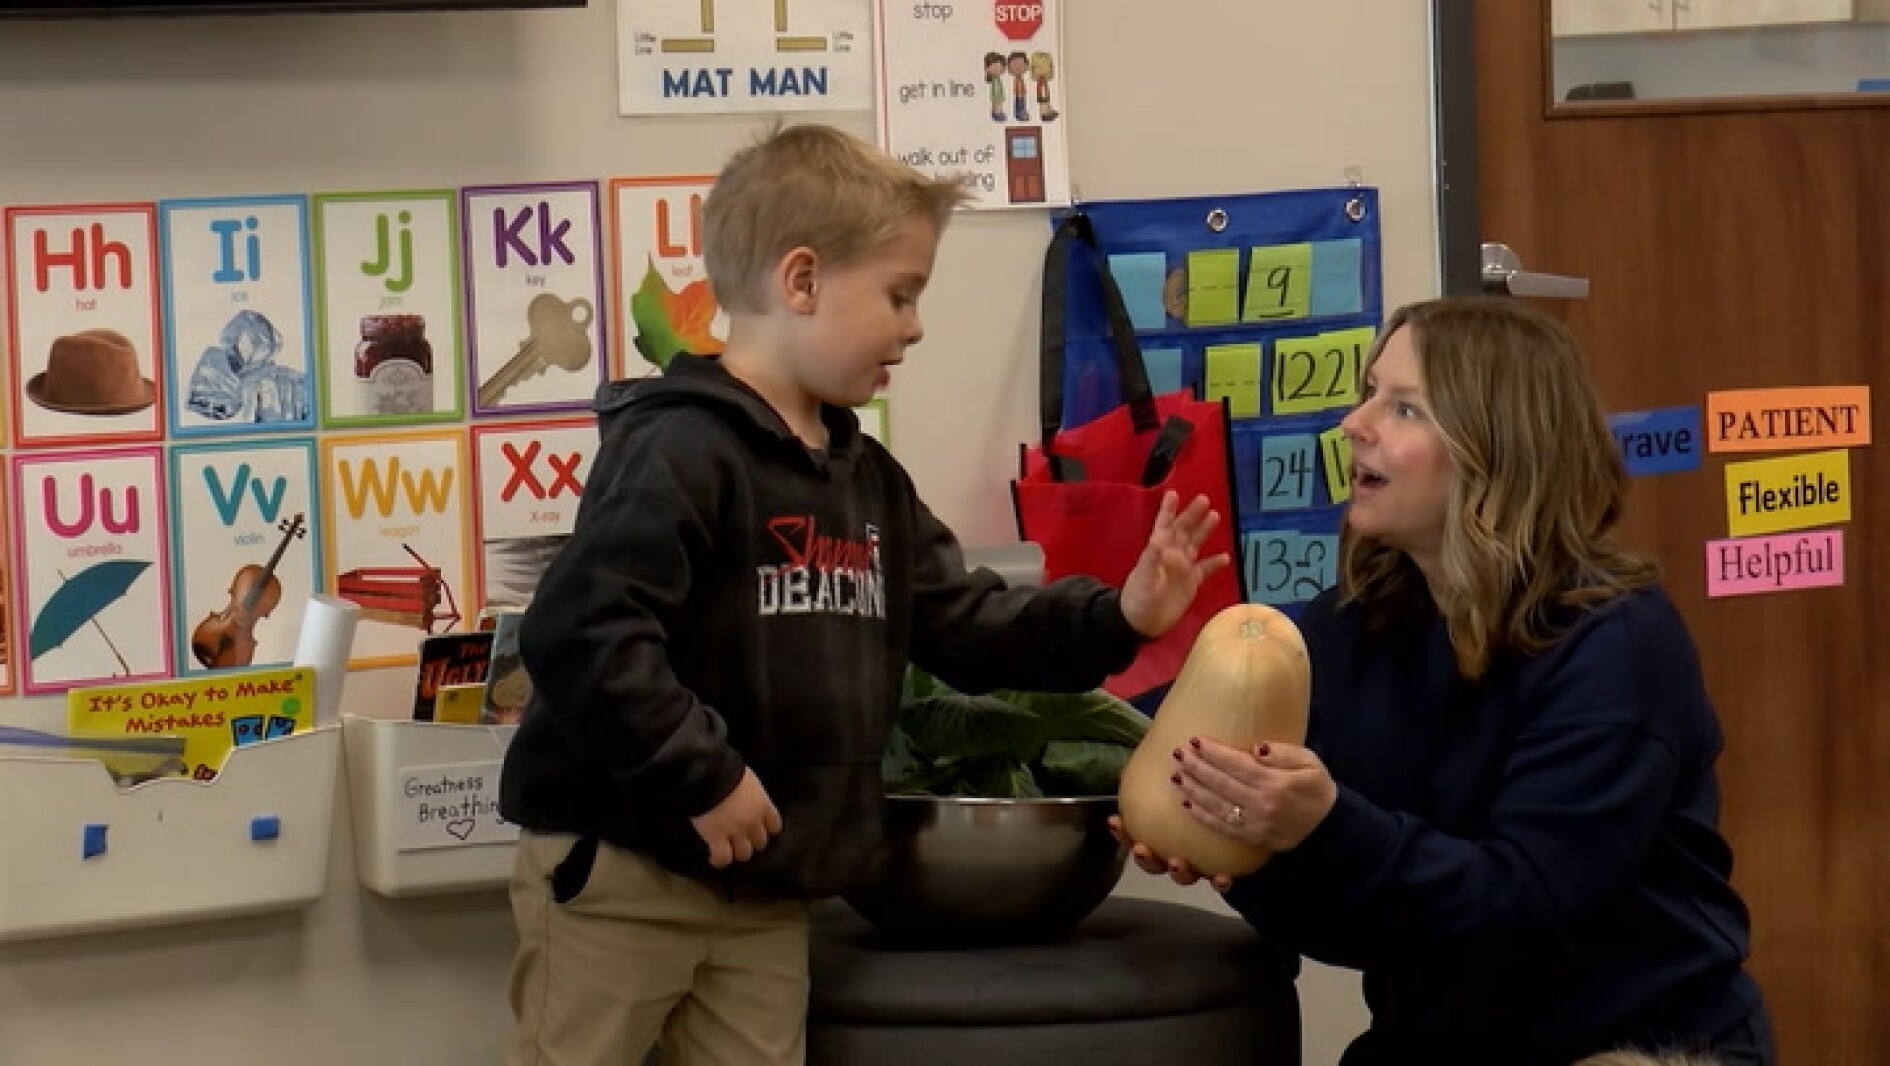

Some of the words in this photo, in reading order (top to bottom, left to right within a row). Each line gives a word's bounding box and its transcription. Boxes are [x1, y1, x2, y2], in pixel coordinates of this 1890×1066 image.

[913, 3, 953, 21] stop
[997, 4, 1043, 22] STOP
[663, 67, 733, 97] MAT
[749, 67, 828, 96] MAN
[899, 81, 926, 103] get
[932, 82, 945, 98] in
[949, 80, 975, 98] line
[938, 146, 967, 166] out
[973, 144, 995, 163] of
[209, 215, 261, 283] Ii
[359, 209, 413, 293] Jj
[492, 201, 576, 269] Kk
[33, 222, 132, 292] Hh
[524, 274, 546, 288] key
[1266, 266, 1292, 308] 9
[75, 298, 98, 312] hat
[1716, 404, 1860, 442] PATIENT
[1614, 427, 1692, 460] rave
[337, 456, 454, 520] Ww
[500, 440, 584, 503] Xx
[1265, 449, 1313, 499] 24
[42, 472, 140, 539] Uu
[201, 462, 287, 526] Vv
[1738, 472, 1840, 515] Flexible
[67, 542, 124, 558] umbrella
[1718, 537, 1834, 587] Helpful
[88, 694, 132, 713] It's
[141, 690, 198, 710] Okay
[204, 685, 229, 702] to
[235, 678, 295, 697] Make
[125, 711, 226, 733] Mistakes
[403, 774, 484, 798] Greatness
